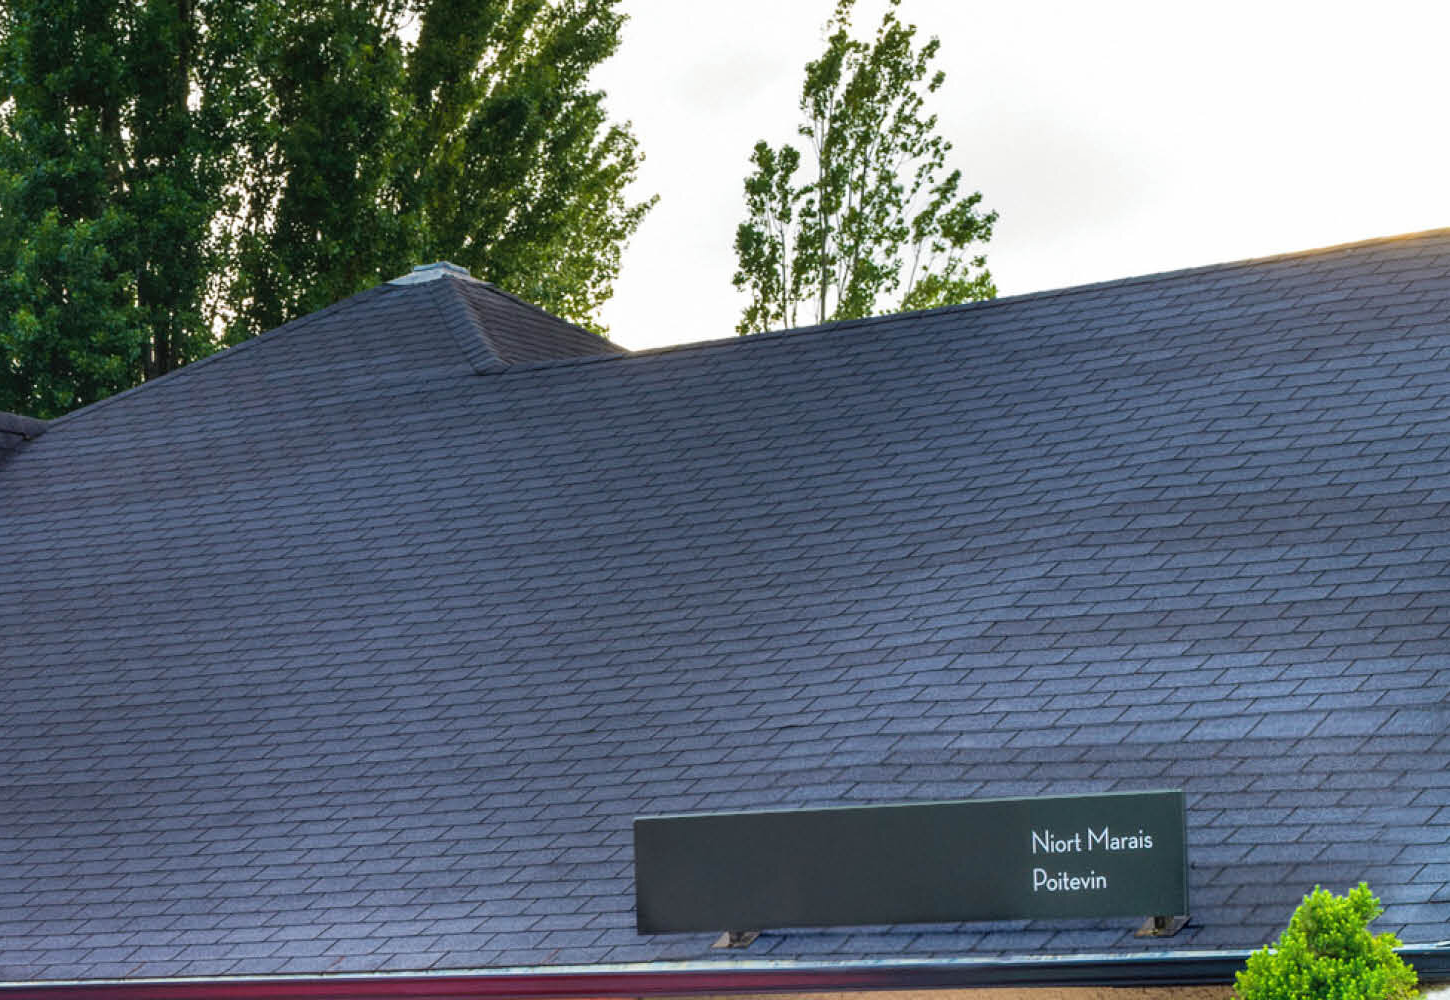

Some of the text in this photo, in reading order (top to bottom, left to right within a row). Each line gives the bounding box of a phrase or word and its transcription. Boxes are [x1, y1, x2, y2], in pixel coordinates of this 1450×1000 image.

[1032, 826, 1153, 854] Niort Marais
[1033, 867, 1107, 892] Poitevin
